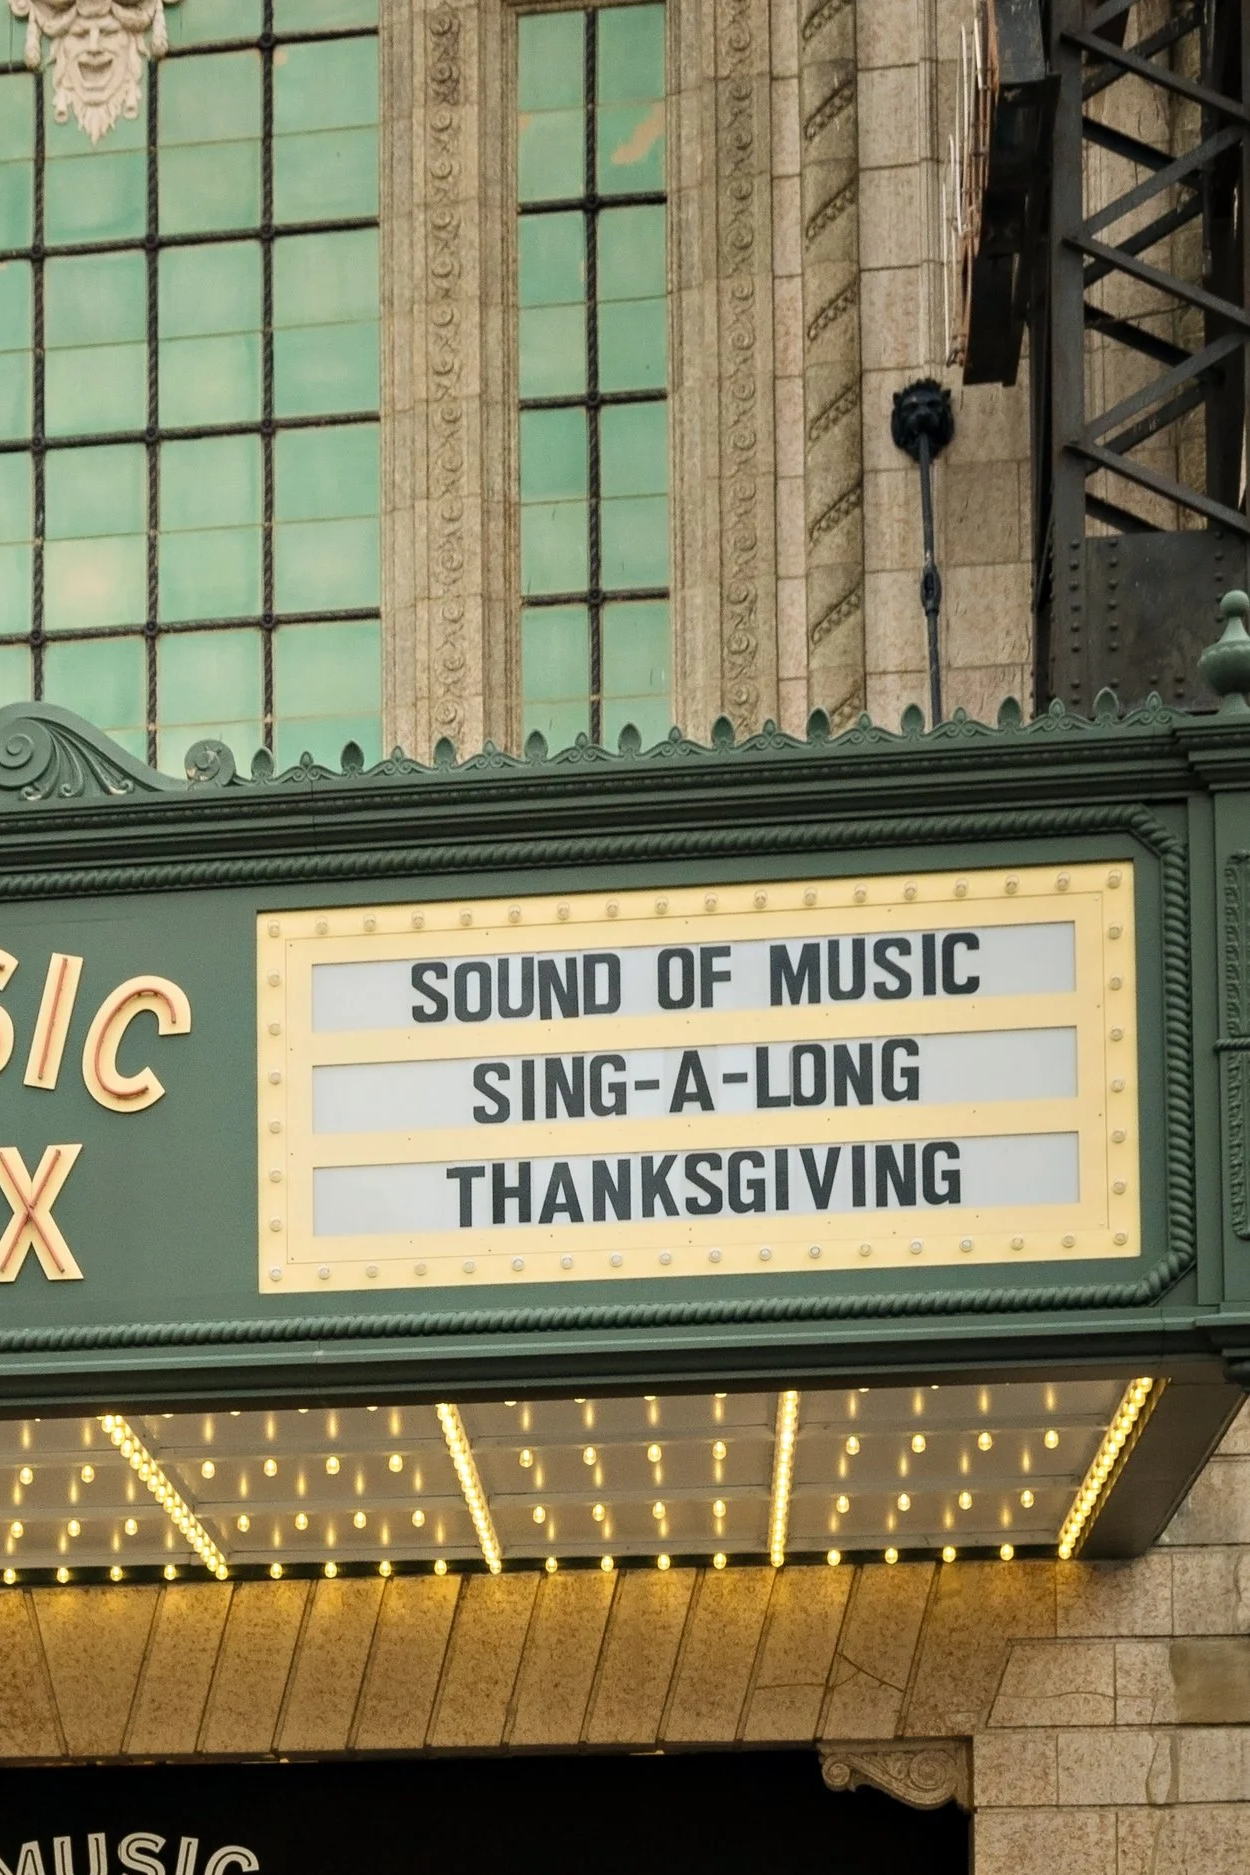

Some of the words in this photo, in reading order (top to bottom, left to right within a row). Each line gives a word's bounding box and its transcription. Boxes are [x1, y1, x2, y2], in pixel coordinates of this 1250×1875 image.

[412, 954, 620, 1022] SOUND
[658, 946, 731, 1009] OF
[770, 933, 979, 1006] MUSIC
[474, 1039, 919, 1123] SING-A-LONG
[447, 1142, 960, 1227] THANKSGIVING
